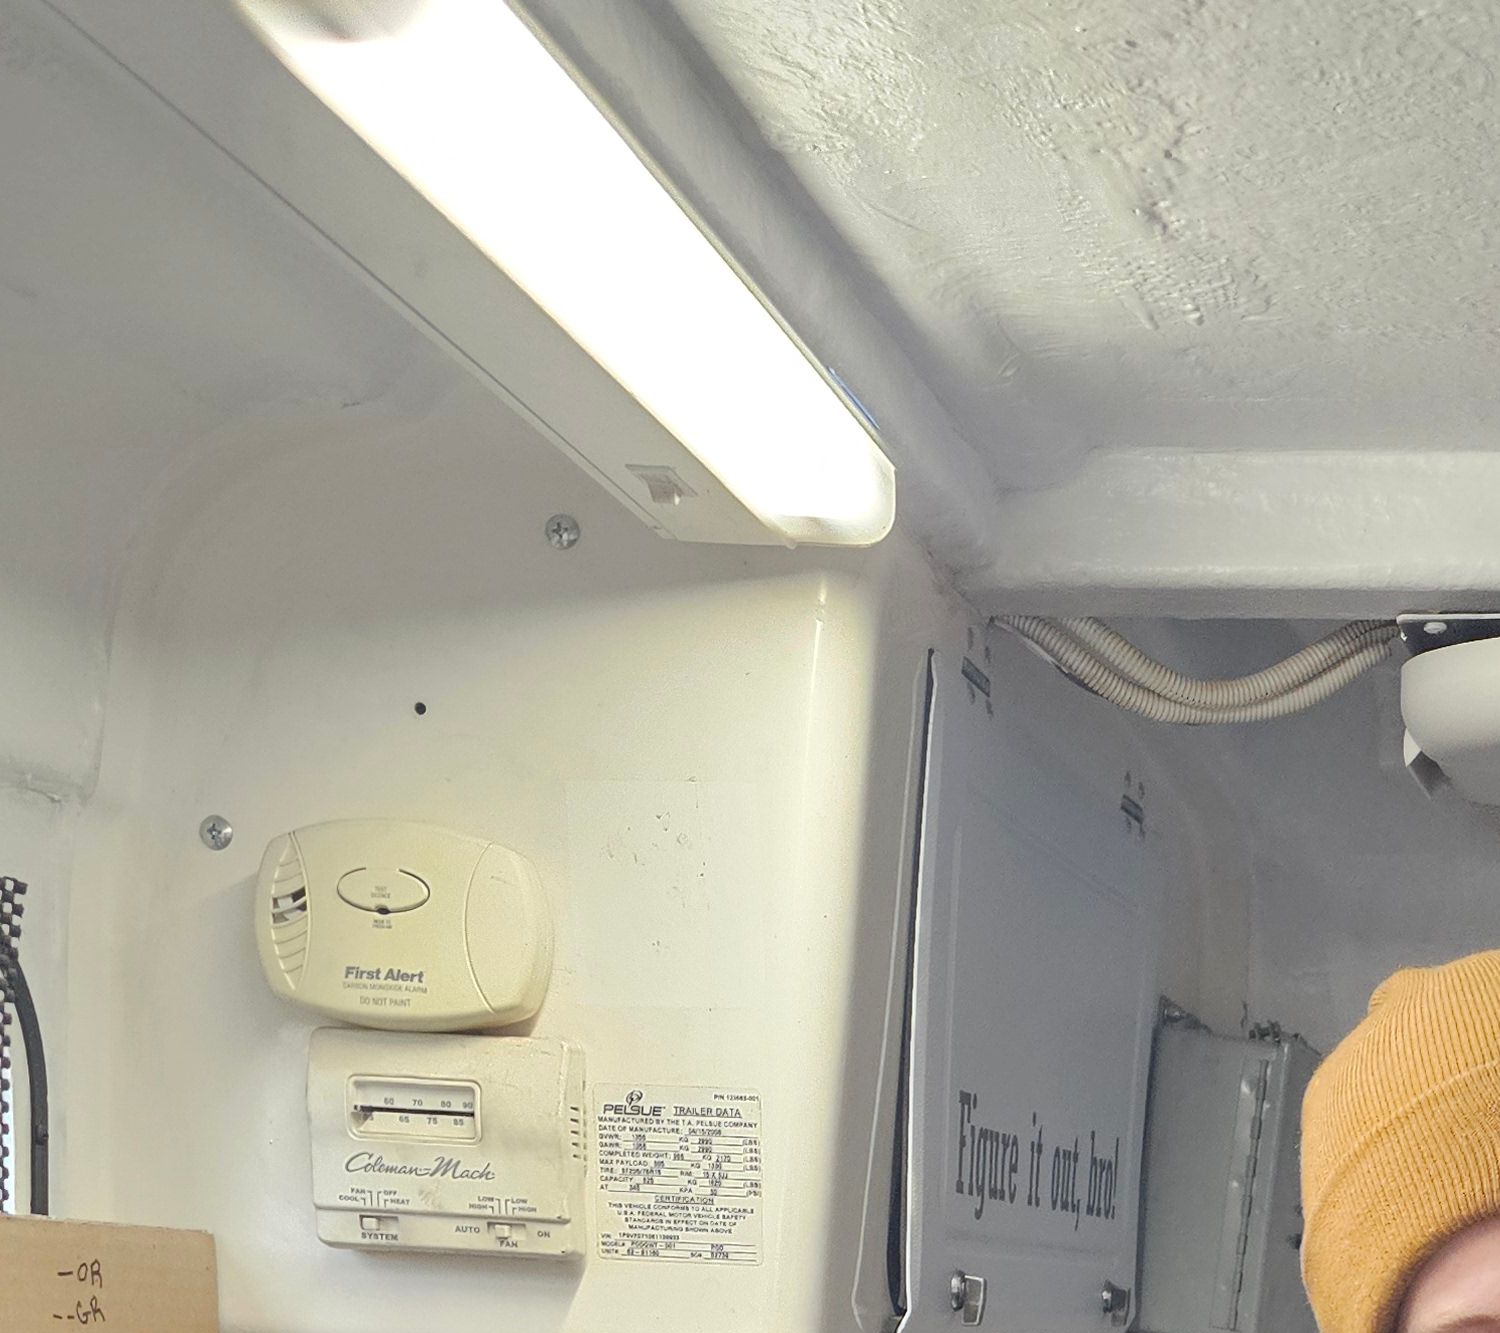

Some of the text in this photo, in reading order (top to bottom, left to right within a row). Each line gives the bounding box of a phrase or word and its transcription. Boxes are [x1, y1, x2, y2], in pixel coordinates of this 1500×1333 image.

[344, 966, 424, 983] First Alert
[360, 996, 411, 1007] DO NOT PAINT
[603, 1104, 662, 1116] PELSUE
[673, 1106, 742, 1117] TRAILER DATA
[427, 1117, 438, 1125] 75
[598, 1116, 654, 1124] MANUFACTURED
[599, 1124, 616, 1132] DATE
[599, 1150, 640, 1158] COMPLETED
[956, 1090, 1119, 1231] Figure it out, bro!
[655, 1195, 714, 1204] CERTIFICATION
[455, 1225, 551, 1238] AUTO ON
[628, 1224, 683, 1232] MANUFACTURING
[361, 1232, 399, 1241] SYSTEM
[499, 1240, 519, 1248] FAN
